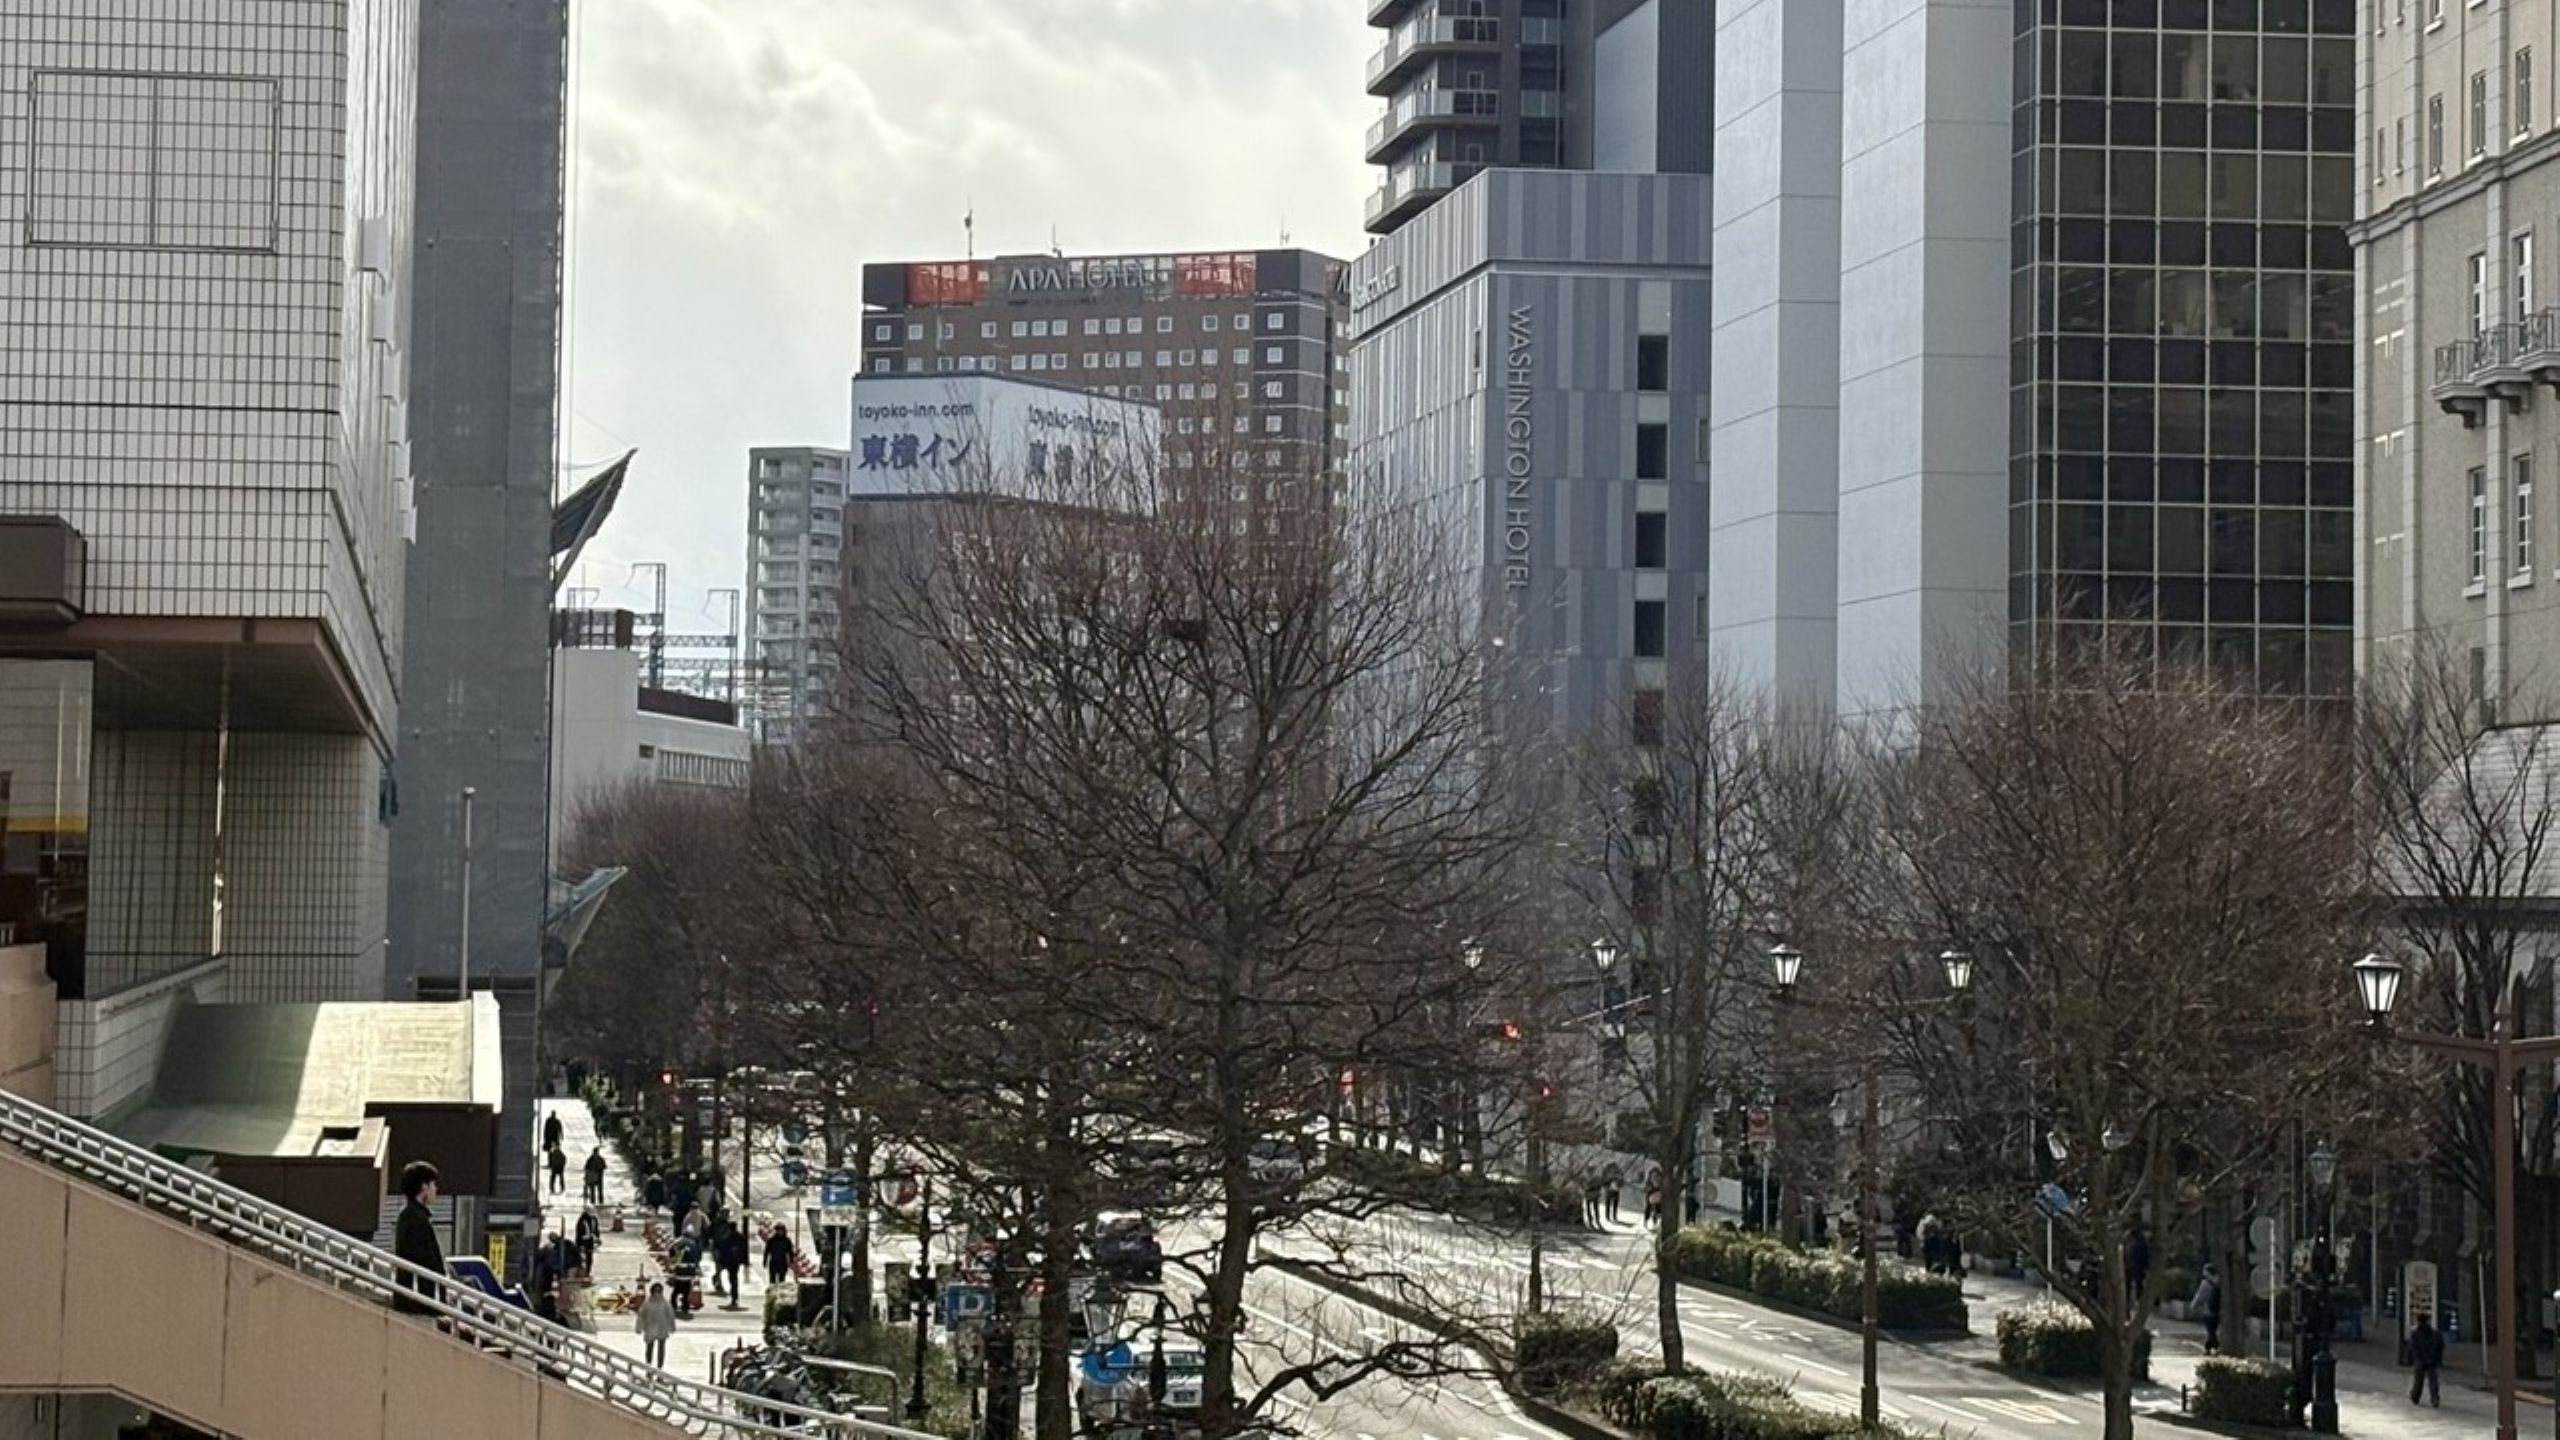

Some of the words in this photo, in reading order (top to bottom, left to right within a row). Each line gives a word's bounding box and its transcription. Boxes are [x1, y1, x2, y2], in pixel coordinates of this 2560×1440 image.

[1009, 267, 1062, 296] APA
[1064, 260, 1150, 290] HOTEL
[858, 401, 973, 422] toyoko-inn.com
[1507, 303, 1532, 499] WASHINGTON
[857, 432, 973, 472] 東横イン
[1504, 508, 1530, 592] HOTEL
